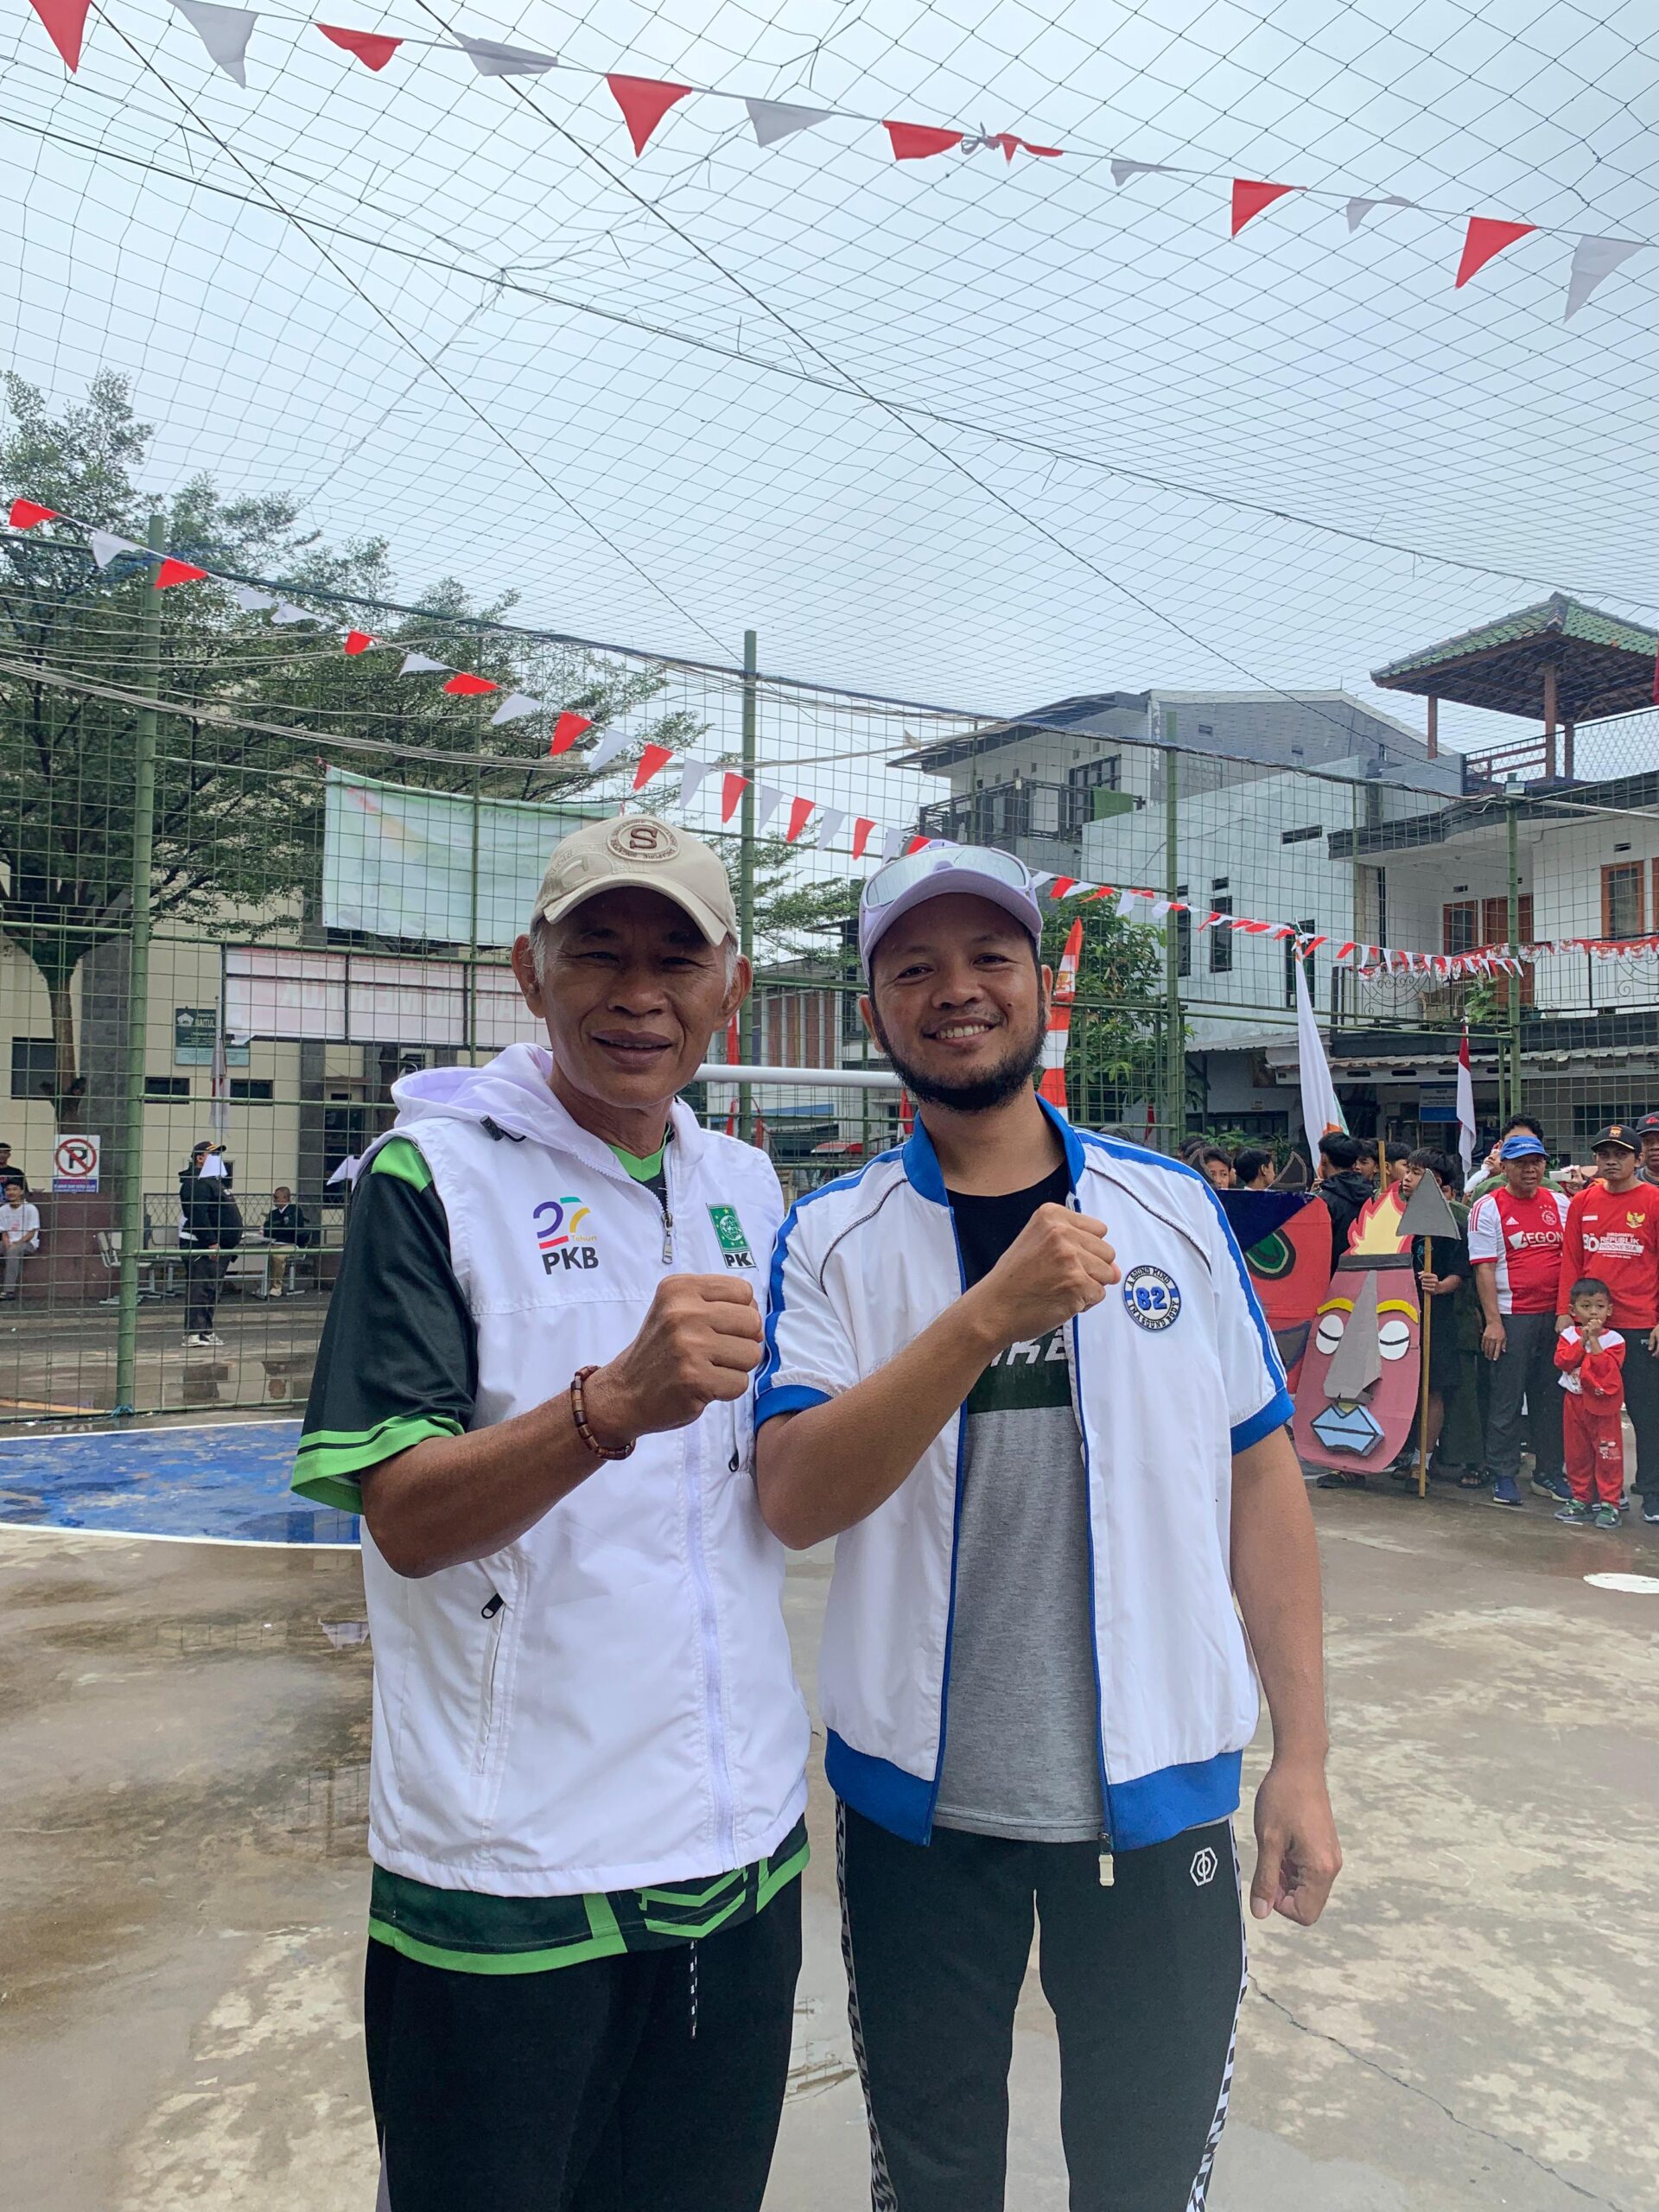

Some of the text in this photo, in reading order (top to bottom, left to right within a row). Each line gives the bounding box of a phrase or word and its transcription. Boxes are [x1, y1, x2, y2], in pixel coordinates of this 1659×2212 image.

[630, 827, 658, 849] S
[572, 1234, 597, 1243] Tahun
[1599, 1236, 1640, 1245] REPUBLIK
[1600, 1243, 1638, 1252] INDONESIA
[542, 1246, 599, 1275] PKB
[1131, 1268, 1150, 1279] SOUND
[1153, 1268, 1170, 1284] MIND
[1135, 1287, 1167, 1311] 82
[1128, 1303, 1137, 1314] IN
[1141, 1318, 1166, 1328] SOUND
[1166, 1301, 1179, 1322] BODY
